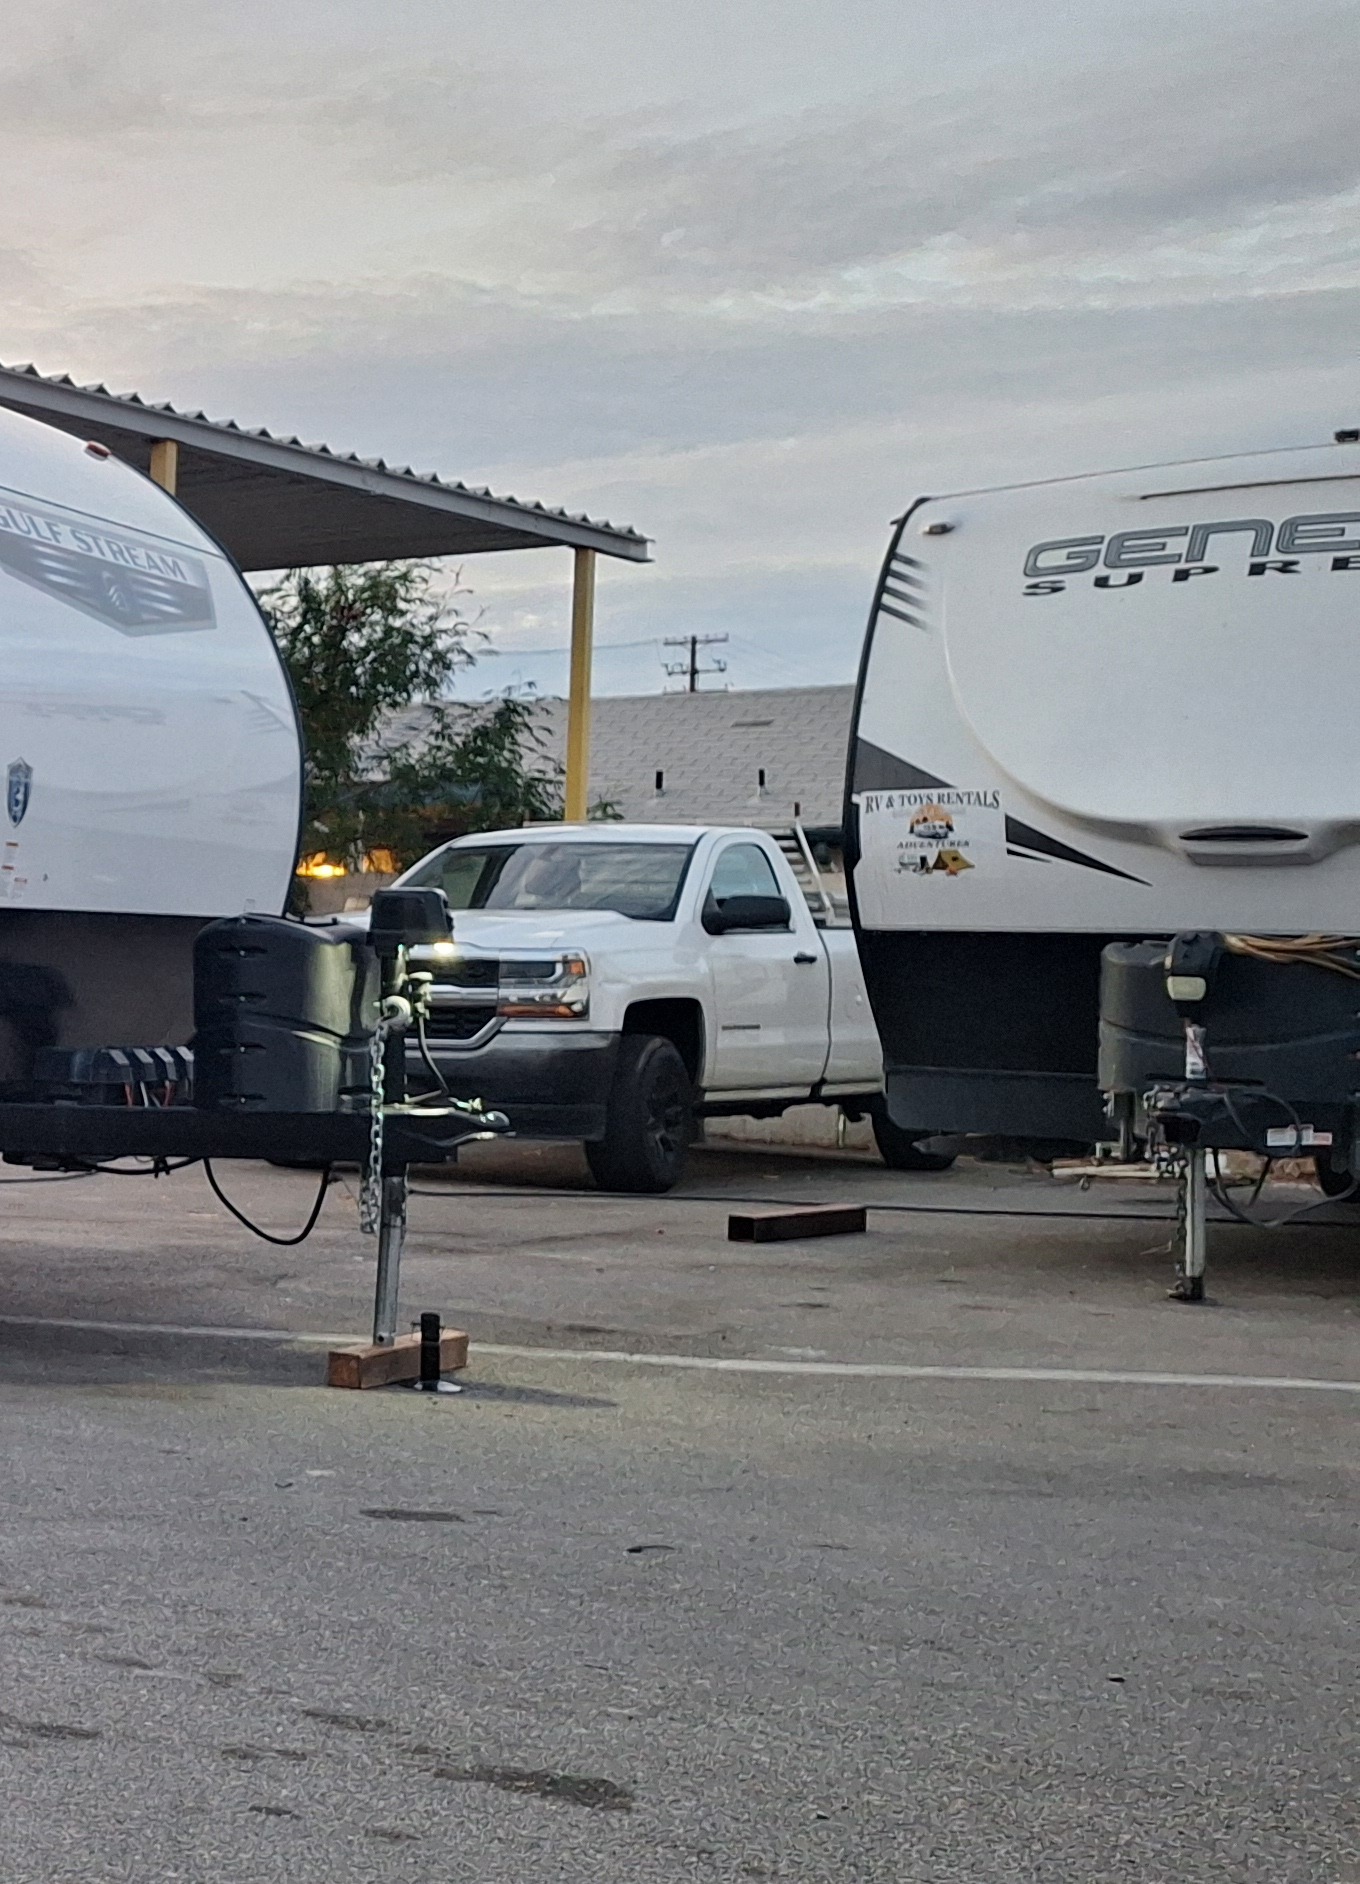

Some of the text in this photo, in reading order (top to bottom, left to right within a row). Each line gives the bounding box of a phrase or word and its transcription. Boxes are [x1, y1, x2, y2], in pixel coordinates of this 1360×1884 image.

[70, 529, 188, 581] STREAM
[1023, 511, 1360, 577] GENE
[865, 795, 883, 814] RV
[886, 794, 895, 809] &
[898, 793, 934, 807] TOYS
[937, 790, 1001, 809] RENTALS
